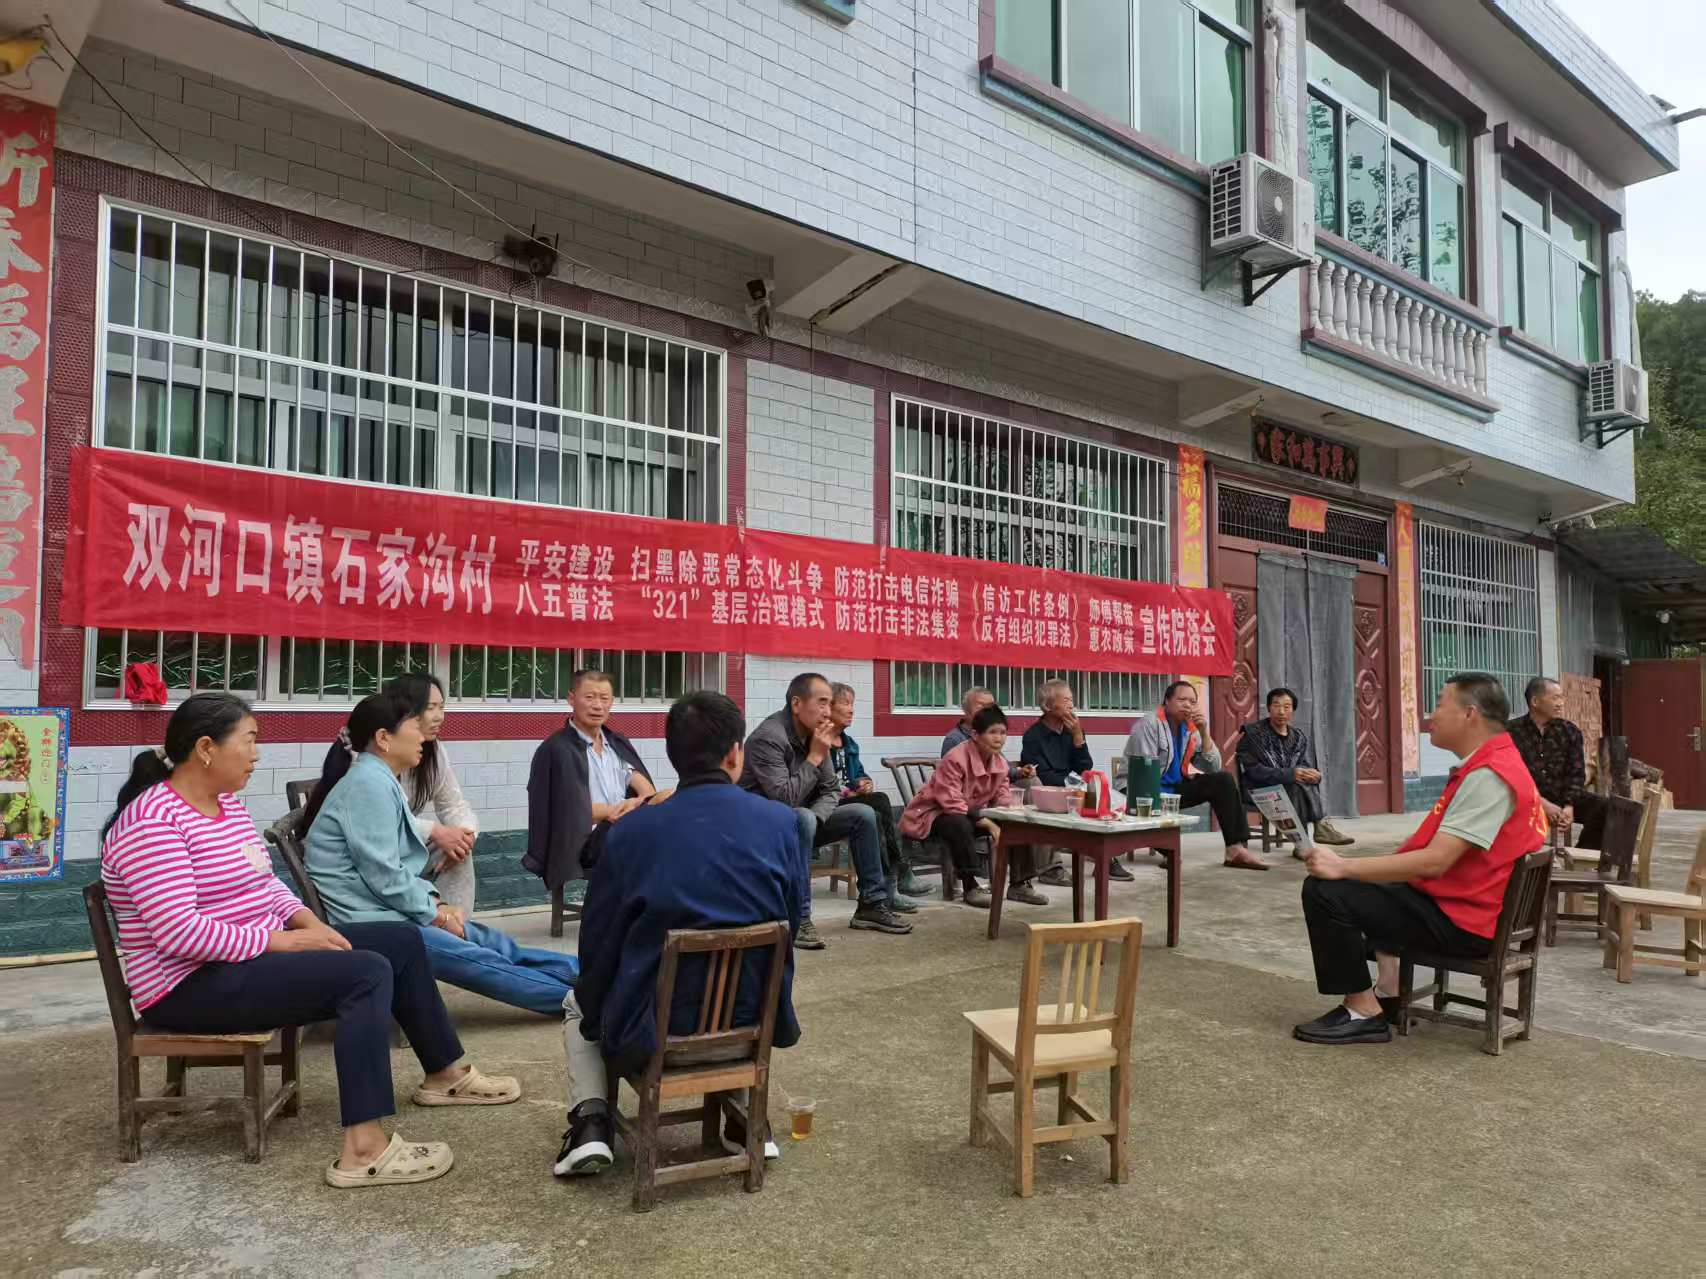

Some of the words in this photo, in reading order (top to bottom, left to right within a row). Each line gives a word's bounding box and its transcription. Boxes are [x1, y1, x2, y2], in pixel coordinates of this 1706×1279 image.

[123, 503, 495, 613] 双河口镇石家沟村
[517, 540, 614, 582] 平安建设
[631, 546, 823, 595] 扫黑除恶常态化斗争
[835, 566, 958, 607] 防范打击电信诈骗
[516, 582, 613, 620] 八五普法
[712, 590, 824, 629] 基层治理模式
[836, 601, 958, 639] 防范打击非法集资
[1089, 626, 1134, 653] 惠农政策
[1140, 605, 1215, 656] 宣传院落会
